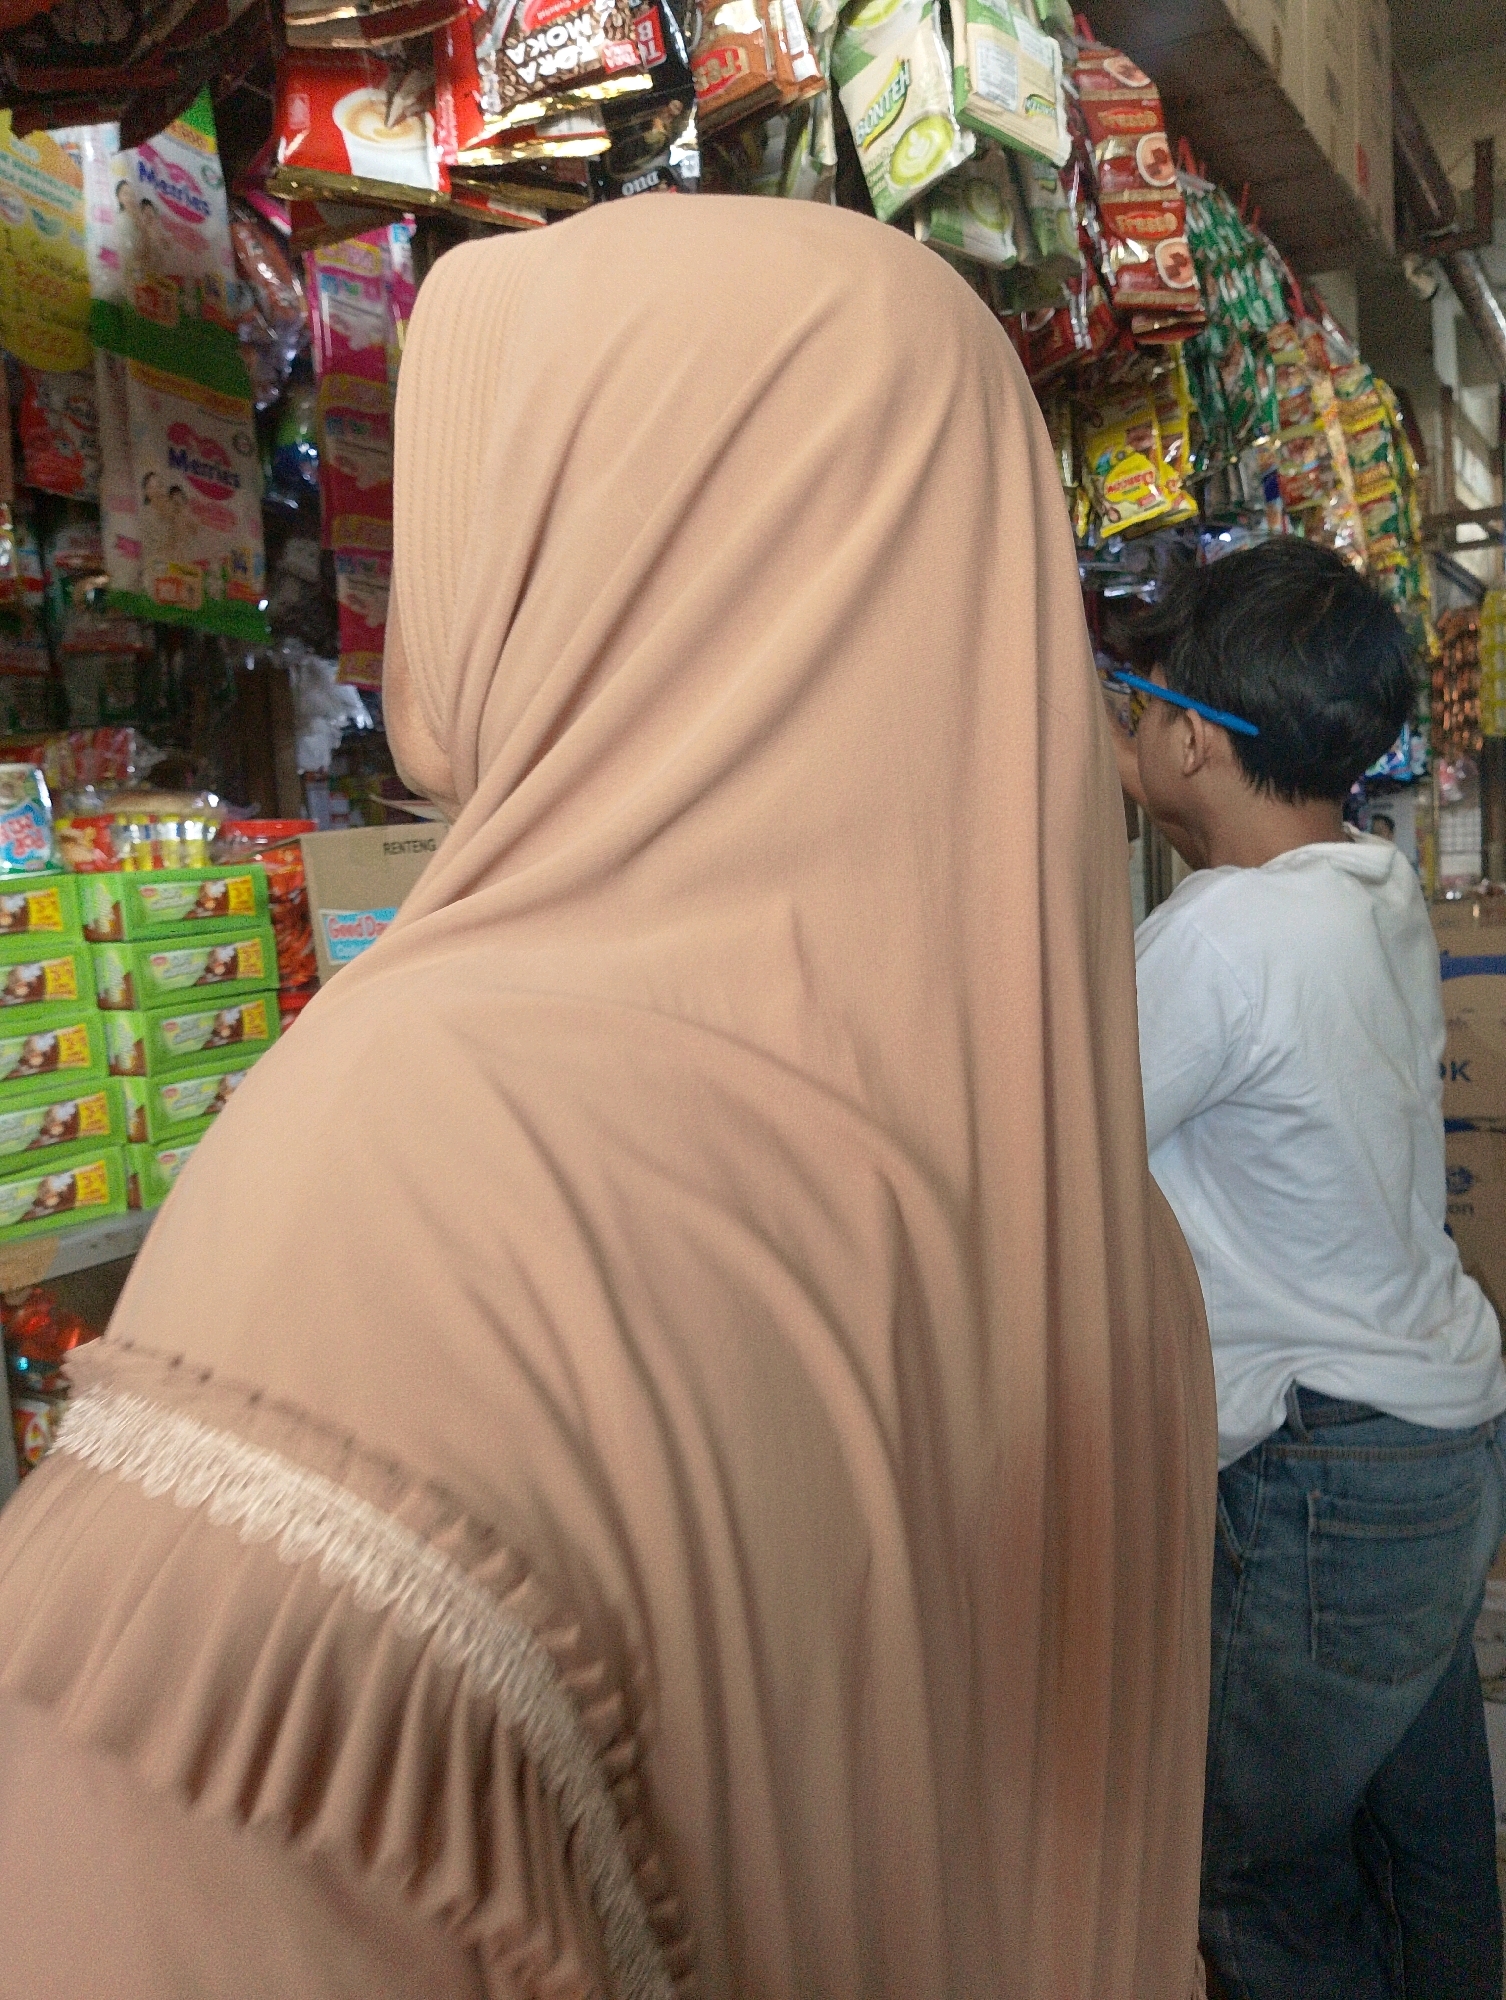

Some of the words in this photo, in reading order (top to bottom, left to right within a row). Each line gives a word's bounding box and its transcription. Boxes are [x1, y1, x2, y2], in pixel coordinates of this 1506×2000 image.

[505, 14, 593, 64] MOKA
[516, 36, 598, 84] TORA
[383, 838, 437, 856] RENTENG
